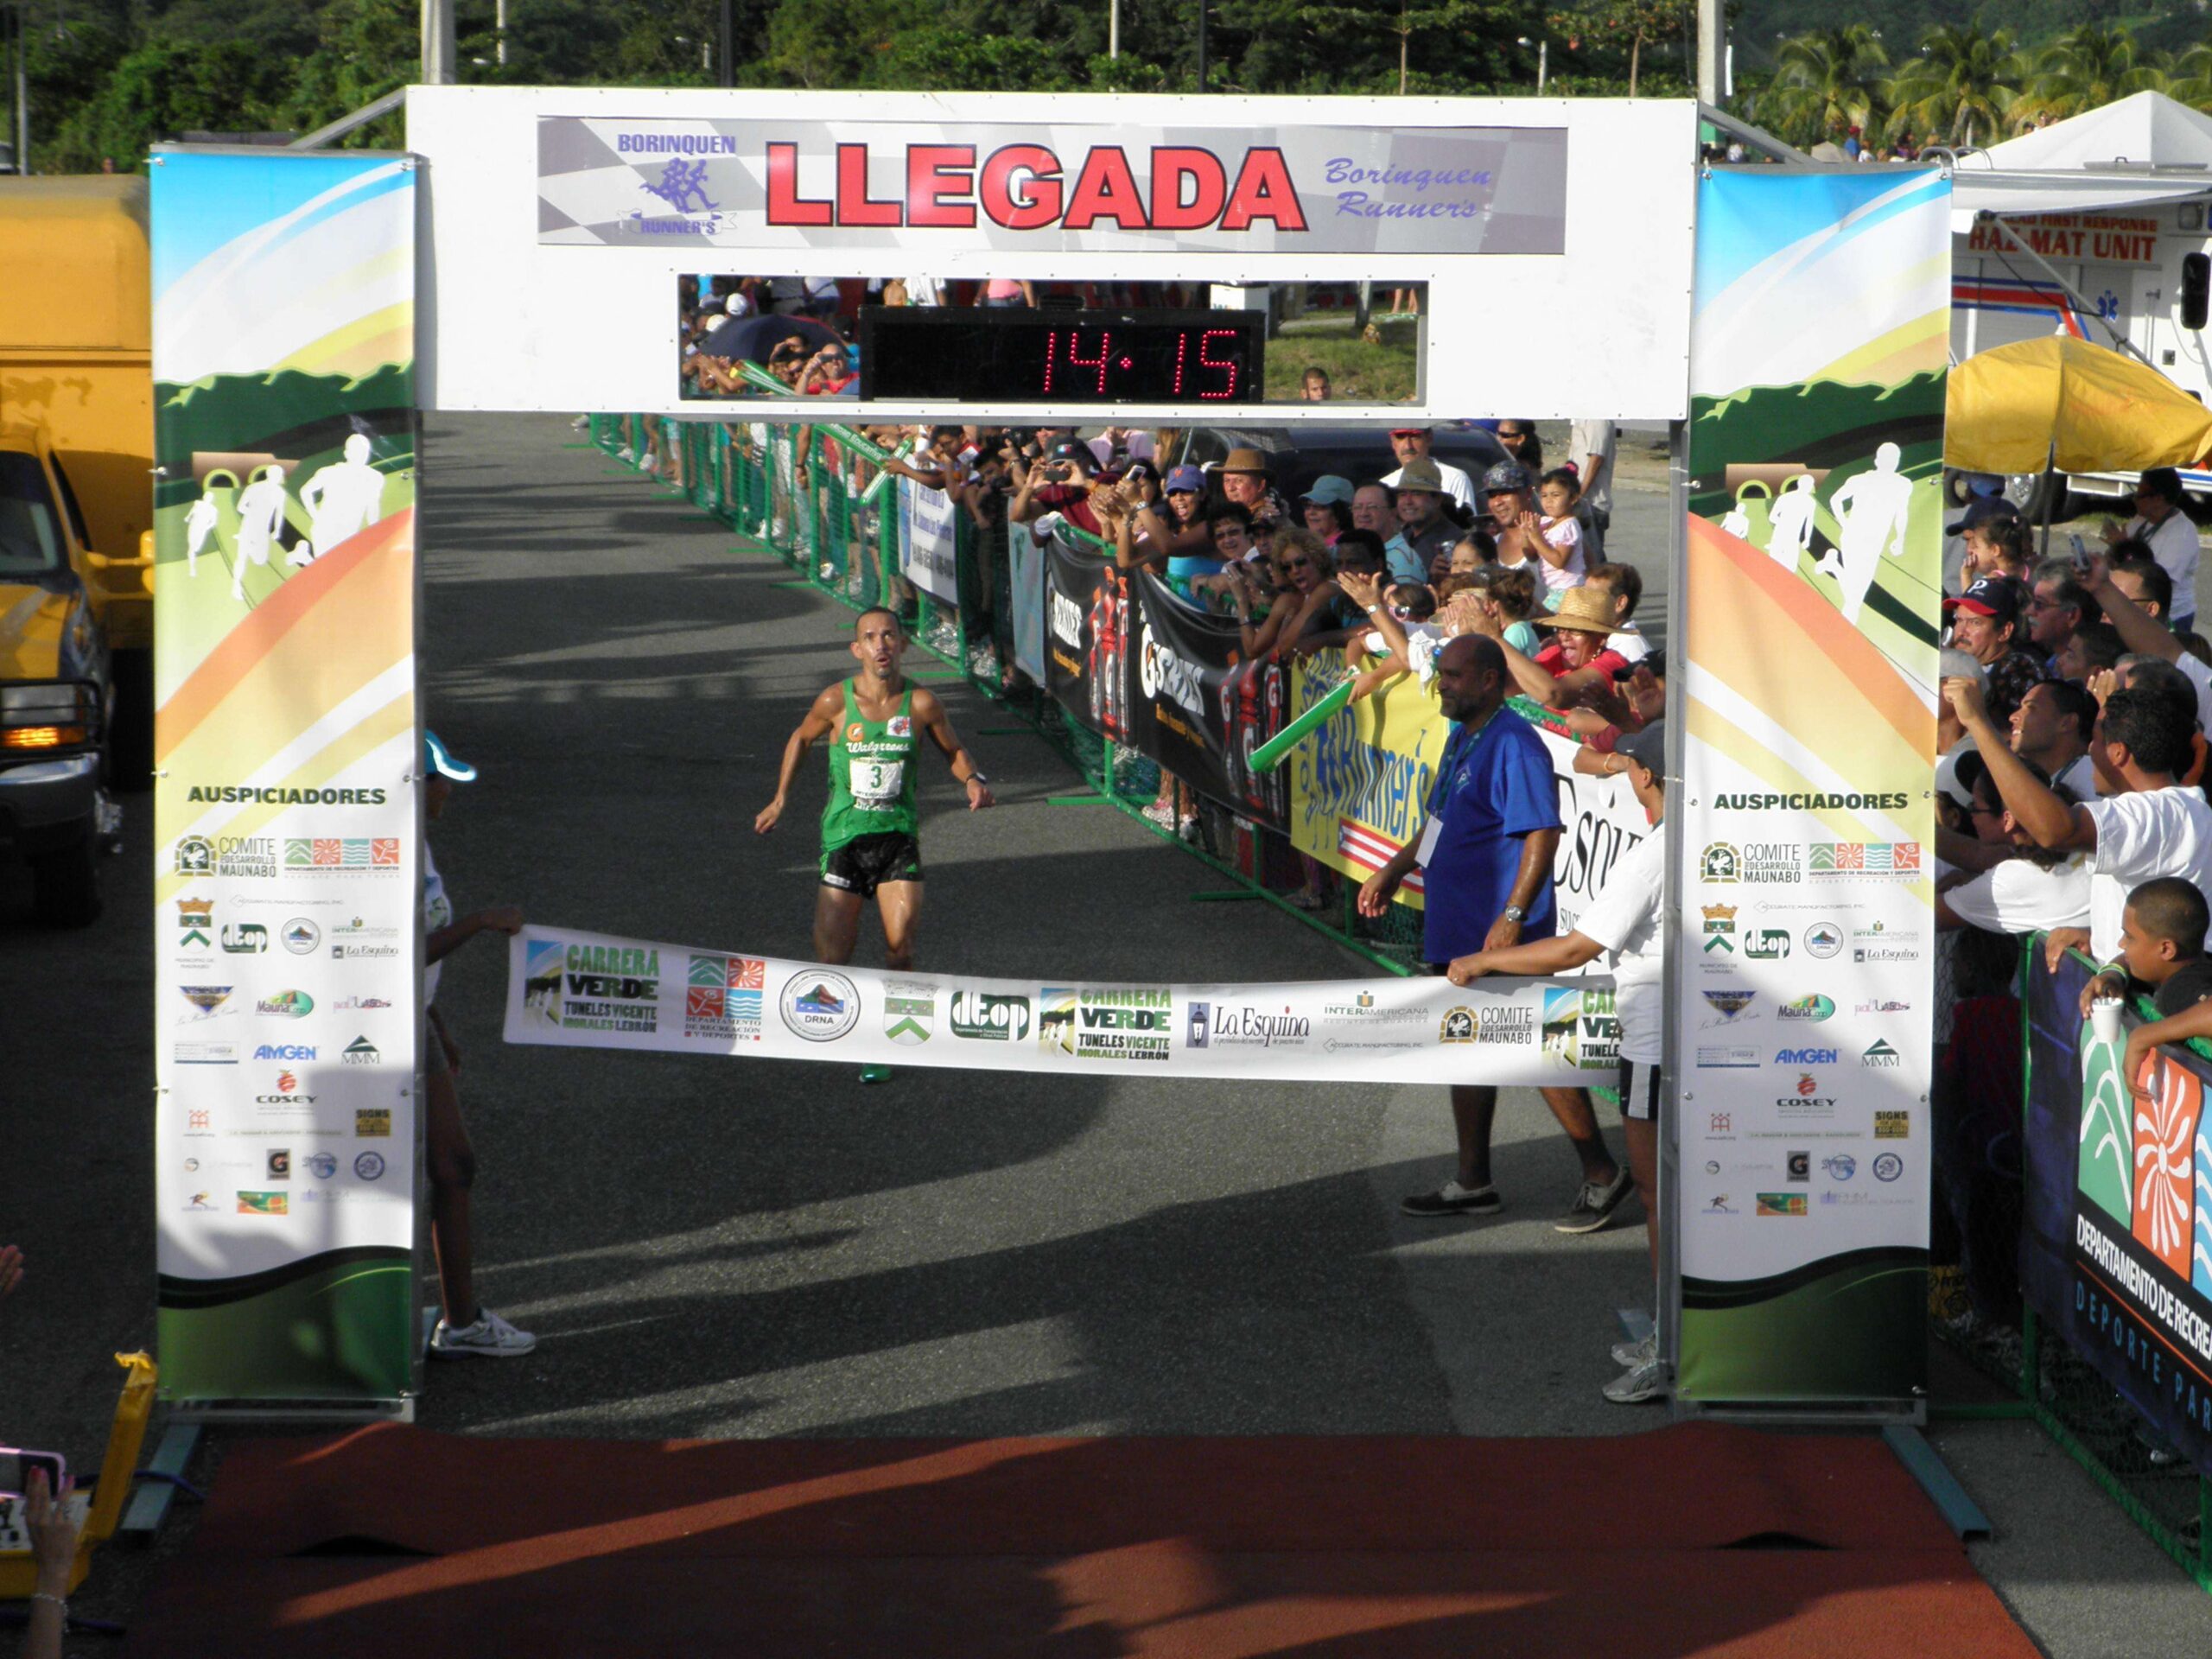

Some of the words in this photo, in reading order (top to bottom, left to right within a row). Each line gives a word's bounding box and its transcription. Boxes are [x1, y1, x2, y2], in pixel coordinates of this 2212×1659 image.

[618, 134, 736, 156] BORINQUEN
[1325, 157, 1491, 192] Borinquen
[766, 141, 1309, 232] LLEGADA
[1335, 191, 1478, 219] Runner's
[640, 220, 716, 235] RUNNER'S
[2083, 216, 2158, 233] RESPONSE
[2094, 232, 2158, 262] UNIT
[846, 741, 910, 754] Walgreens
[870, 765, 883, 790] 3
[187, 785, 386, 805] AUSPICIADORES
[1713, 792, 1909, 810] AUSPICIADORES
[219, 836, 276, 856] COMITE
[1744, 843, 1802, 861] COMITE
[219, 865, 276, 878] MAUNABO
[1744, 871, 1802, 884] MAUNABO
[566, 944, 660, 977] CARRERA
[1866, 949, 1880, 958] La
[1881, 948, 1919, 962] Esquina
[566, 973, 659, 1001] VERDE
[1079, 988, 1173, 1008] CARRERA
[564, 1001, 611, 1017] TUNELES
[612, 1003, 658, 1020] VICENTE
[804, 1014, 836, 1025] DRNA
[1324, 1006, 1429, 1016] INTERAMERICANA
[1481, 1007, 1534, 1025] COMITE
[563, 1017, 613, 1031] MORALES
[614, 1020, 657, 1033] LEBRON
[1080, 1007, 1172, 1033] VERDE
[1213, 1006, 1239, 1036] La
[1242, 1005, 1311, 1047] Esquina
[1078, 1033, 1125, 1048] TUNELES
[1126, 1035, 1171, 1051] VICENTE
[1478, 1031, 1533, 1045] MAUNABO
[253, 1045, 318, 1061] AMGEN
[341, 1052, 380, 1065] MMM
[1077, 1048, 1128, 1060] MORALES
[1128, 1050, 1170, 1061] LEBRON
[1774, 1048, 1838, 1065] AMGEN
[1862, 1055, 1900, 1067] MMM
[256, 1095, 318, 1104] COSEY
[1777, 1098, 1837, 1107] COSEY
[2076, 1213, 2158, 1313] DEPARTAMENTO
[2158, 1283, 2174, 1328] DE
[2076, 1280, 2162, 1384] DEPORTE
